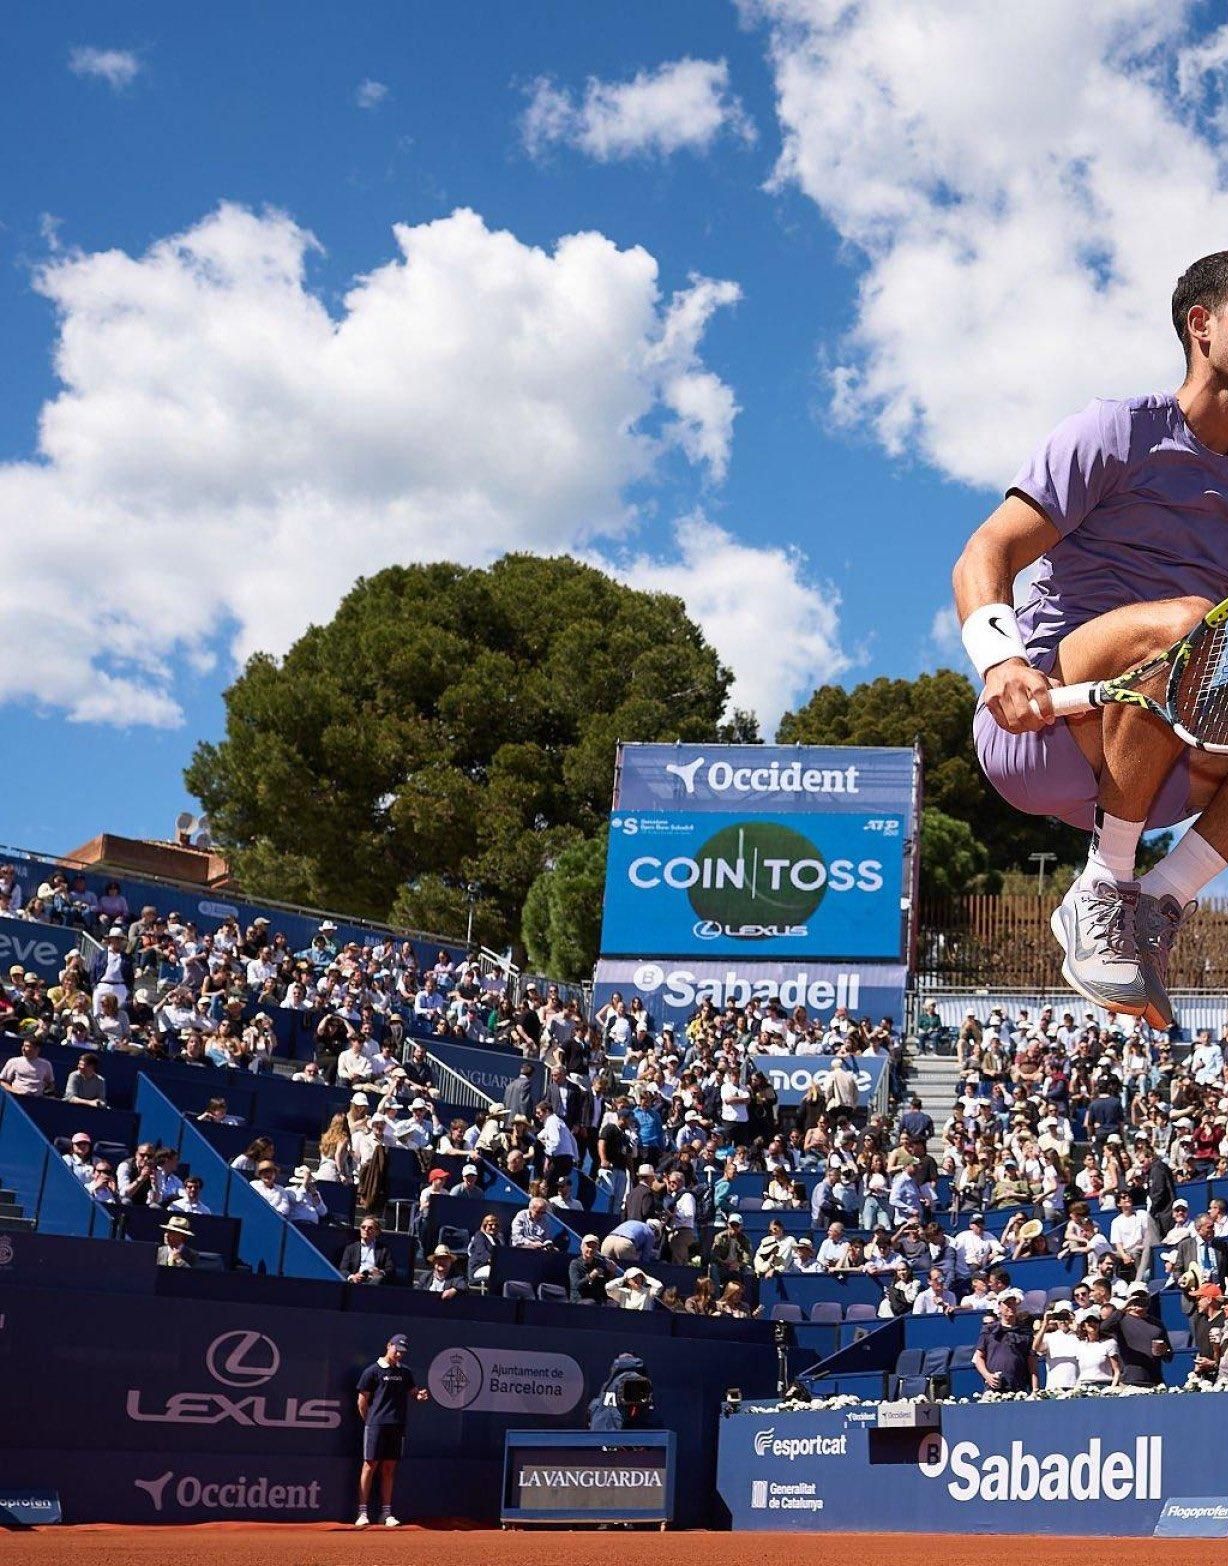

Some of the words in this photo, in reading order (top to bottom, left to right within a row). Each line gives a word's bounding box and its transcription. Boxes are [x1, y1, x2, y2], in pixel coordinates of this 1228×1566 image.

[708, 761, 860, 794] Occident
[628, 856, 745, 889] COIN
[763, 859, 884, 892] TOSS
[725, 924, 809, 937] LEXUS
[663, 970, 861, 1010] Sabadell
[491, 1363, 550, 1378] Ajuntament
[551, 1367, 564, 1379] de
[489, 1378, 563, 1397] Barcelona
[126, 1389, 342, 1430] LEXUS
[772, 1434, 848, 1461] esportcat
[518, 1471, 542, 1487] LA
[542, 1470, 664, 1488] VANGUARDIA
[947, 1435, 1163, 1501] Sabadell
[176, 1476, 320, 1510] Occident
[769, 1482, 817, 1497] Generalitat
[768, 1497, 781, 1509] de
[781, 1497, 824, 1512] Catalunya
